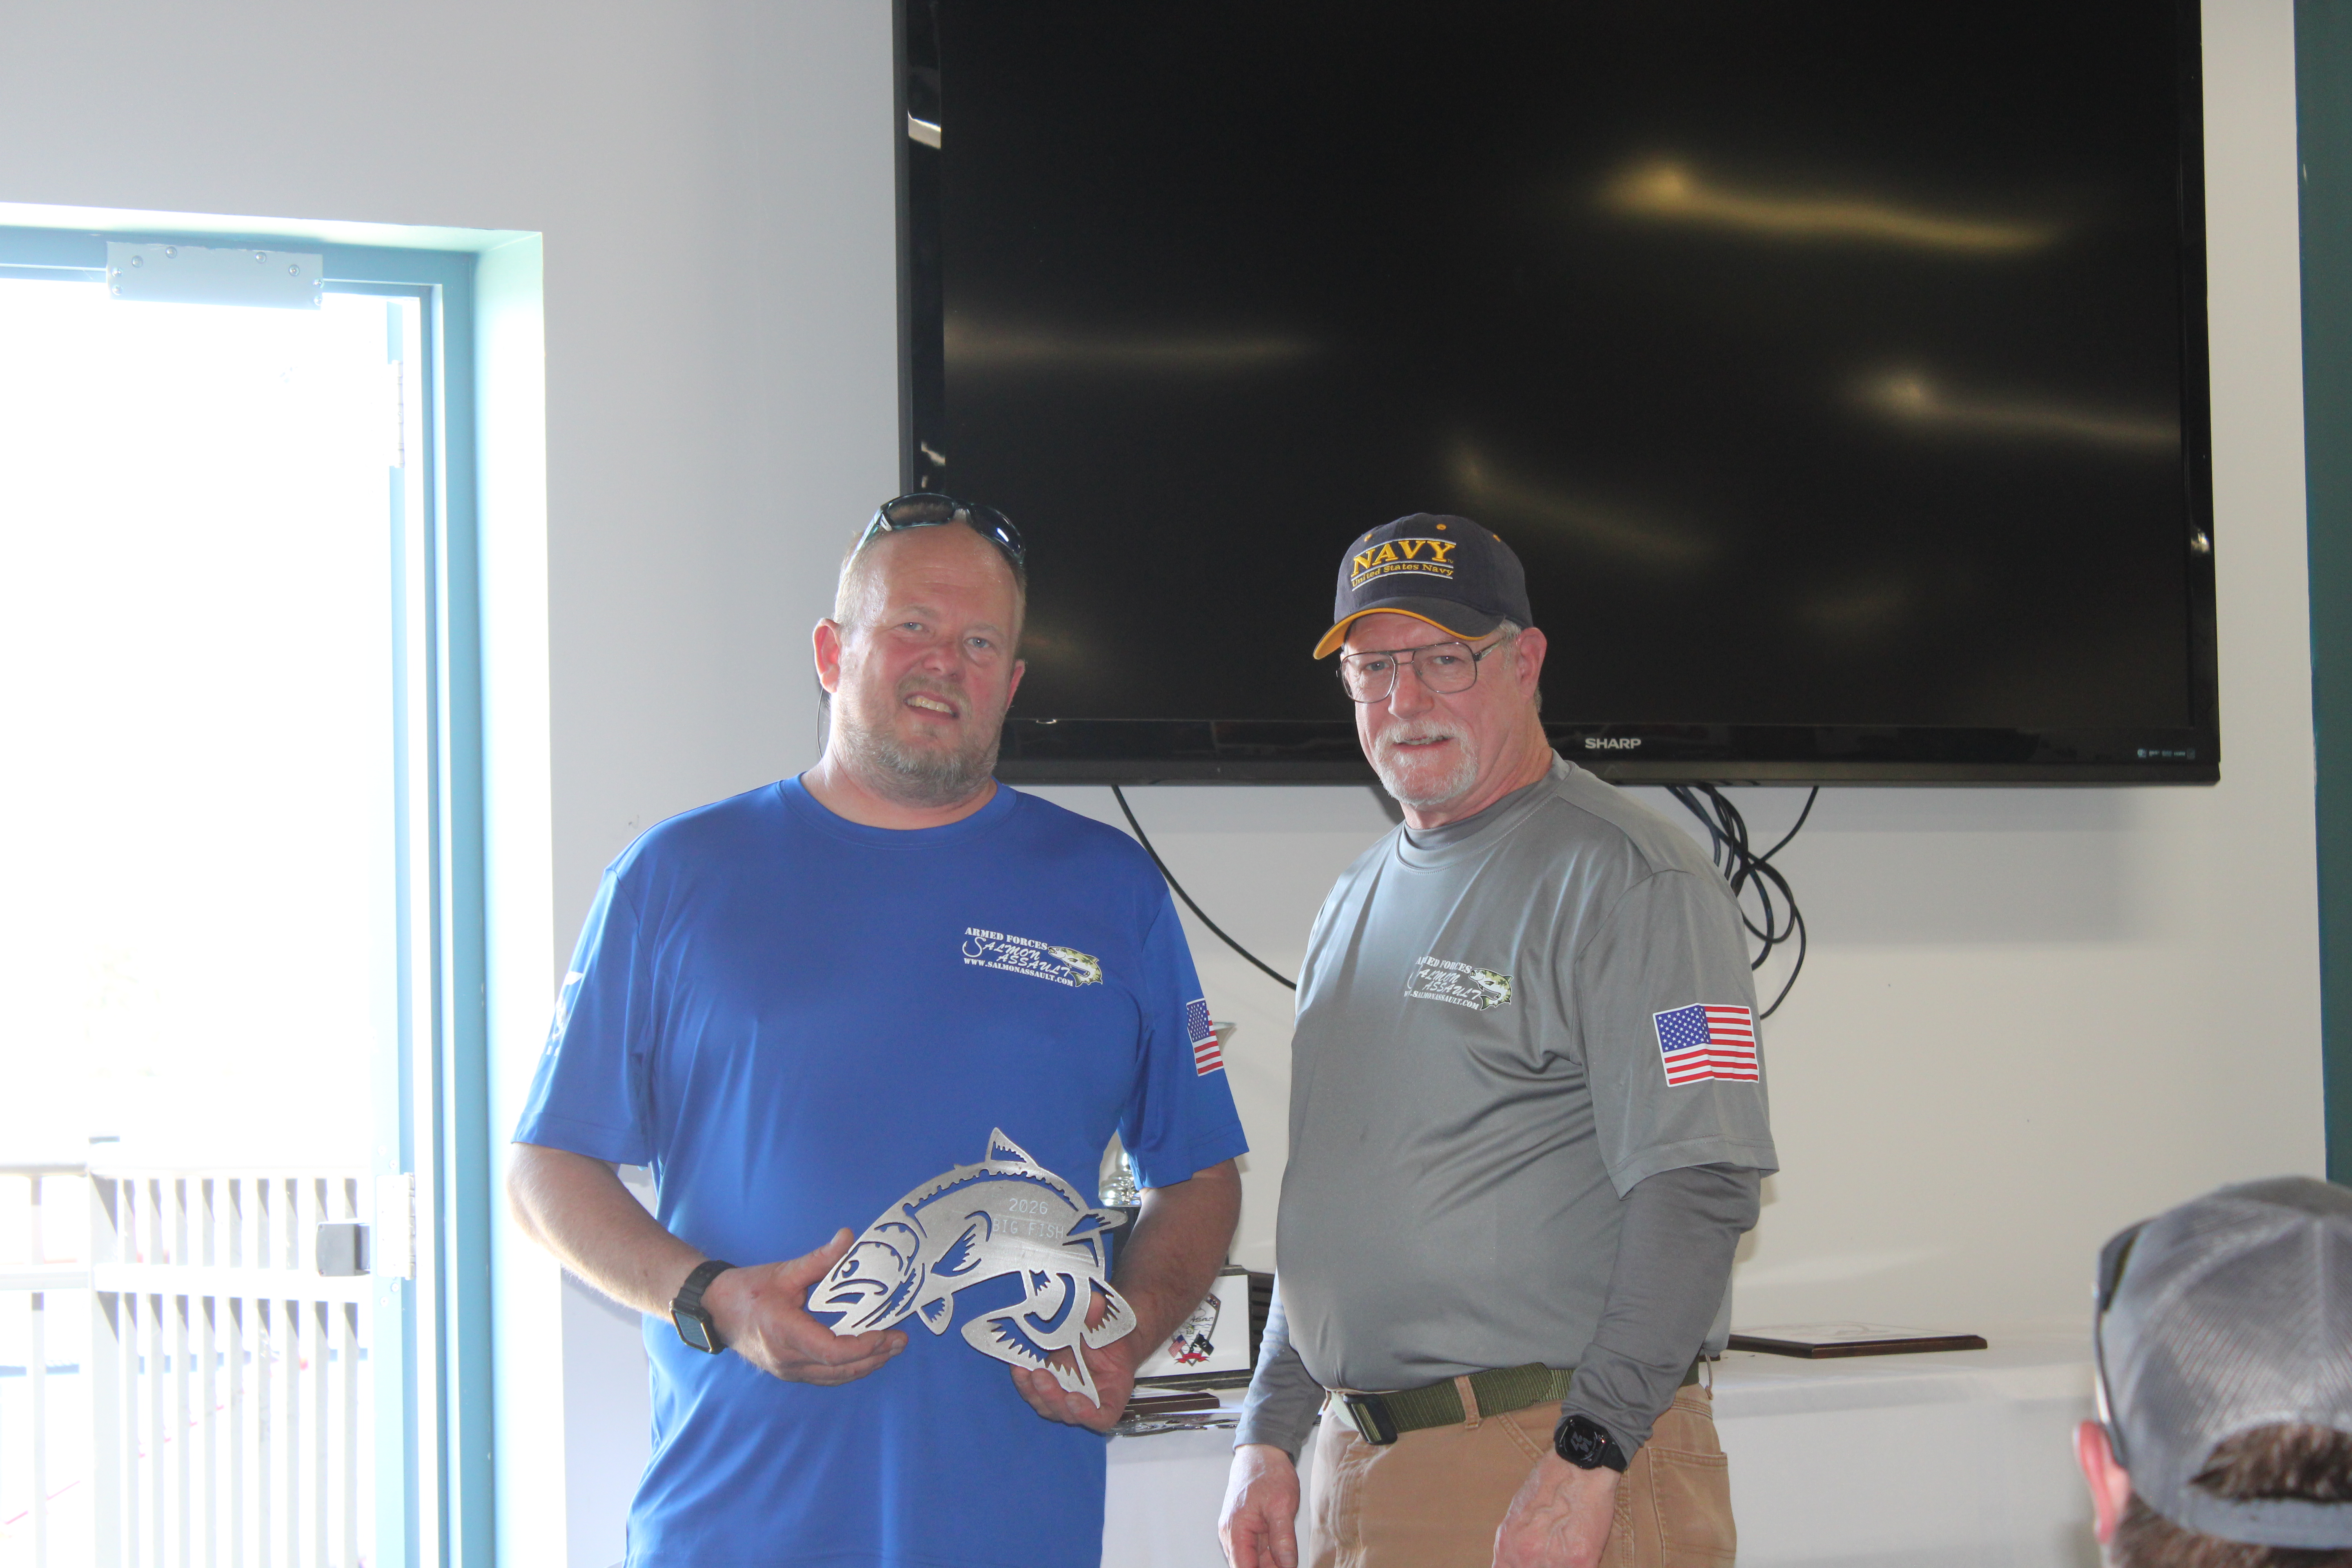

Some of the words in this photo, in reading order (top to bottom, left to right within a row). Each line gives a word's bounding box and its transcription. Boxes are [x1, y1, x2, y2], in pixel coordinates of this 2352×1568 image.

[1350, 540, 1456, 577] NAVY
[1352, 568, 1381, 587] United
[1383, 563, 1419, 572] States
[1422, 563, 1454, 576] Navy
[1585, 738, 1641, 749] SHARP
[962, 936, 1040, 961] SALMON
[964, 927, 1004, 941] ARMED
[1006, 934, 1048, 950] FORCES
[964, 957, 1074, 987] WWW.SALMONASSAULT.COM
[996, 953, 1071, 977] ASSAULT
[1439, 960, 1472, 974] FORCES
[1422, 981, 1482, 1000] ASSAULT
[1009, 1198, 1049, 1214] 2026
[992, 1218, 1018, 1234] BIG
[1029, 1222, 1064, 1239] FISH
